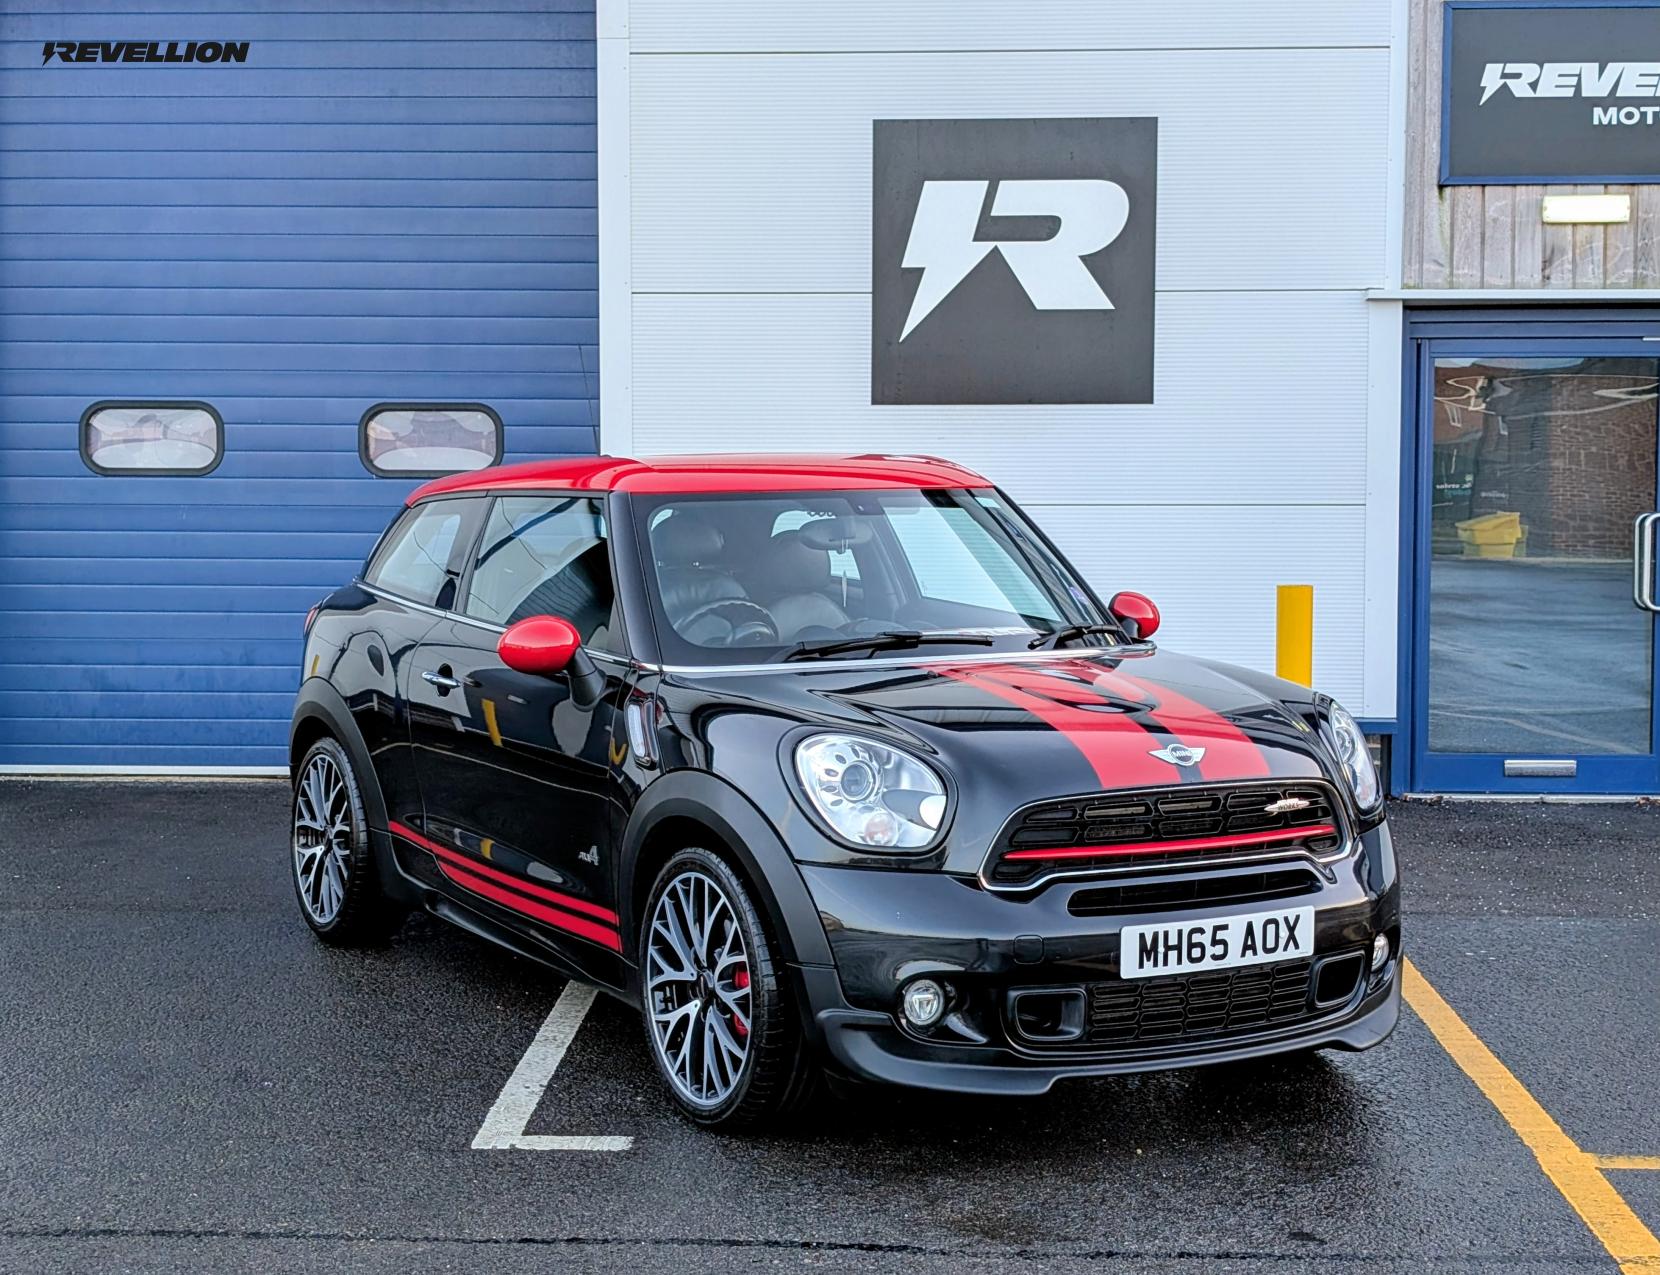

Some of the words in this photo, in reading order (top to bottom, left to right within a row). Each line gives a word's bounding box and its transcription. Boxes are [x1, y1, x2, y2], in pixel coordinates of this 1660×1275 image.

[1479, 62, 1660, 106] REVE
[1593, 106, 1660, 125] MOT
[1138, 924, 1229, 969] MH65
[1240, 914, 1301, 958] AOX
